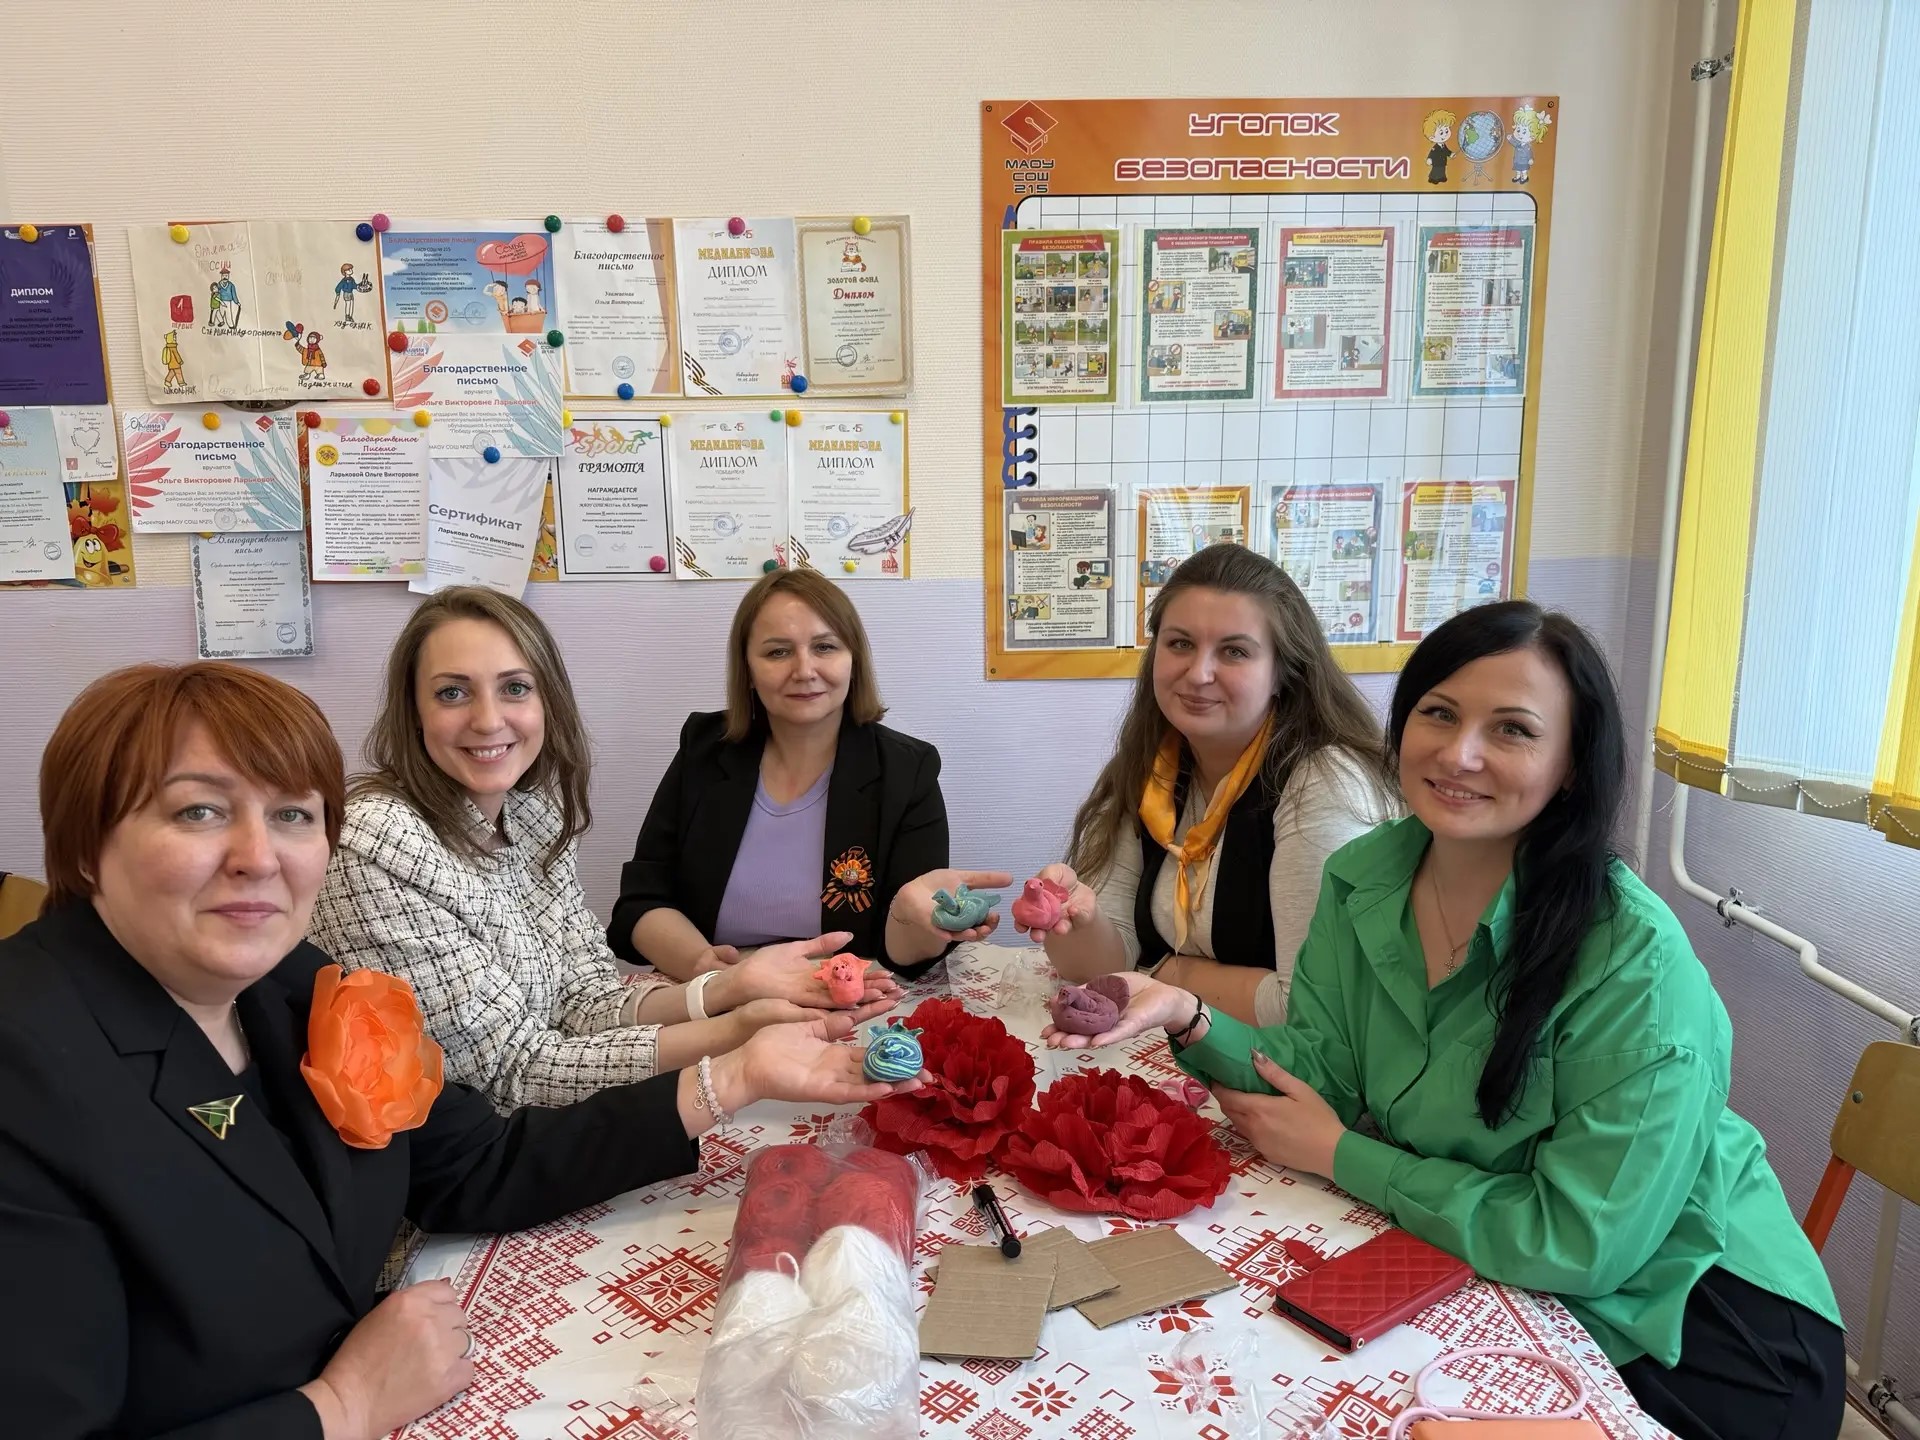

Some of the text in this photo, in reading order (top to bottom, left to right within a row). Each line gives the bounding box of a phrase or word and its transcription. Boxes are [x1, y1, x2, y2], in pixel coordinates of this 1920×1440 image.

[1189, 113, 1339, 136] УГОЛОК
[1005, 160, 1054, 168] МАОУ
[1114, 157, 1410, 182] БЕЗОПАСНОСТИ
[1013, 172, 1049, 181] СОШ
[1014, 185, 1048, 193] 215
[574, 251, 665, 260] Благодарственное
[708, 265, 767, 279] ДИПЛОМ
[11, 288, 53, 297] ДИПЛОМ
[833, 288, 874, 299] Диплом
[423, 364, 528, 374] Благодарственное
[160, 440, 265, 450] Благодарственное
[700, 456, 757, 468] ДИПЛОМ
[817, 457, 874, 469] ДИПЛОМ
[578, 463, 645, 474] ГРАМОТА
[428, 504, 522, 531] Сертификат
[208, 533, 288, 546] Благодарственное
[438, 527, 468, 538] Ларькова
[470, 532, 488, 541] Ольга
[490, 536, 524, 549] Викторовна
